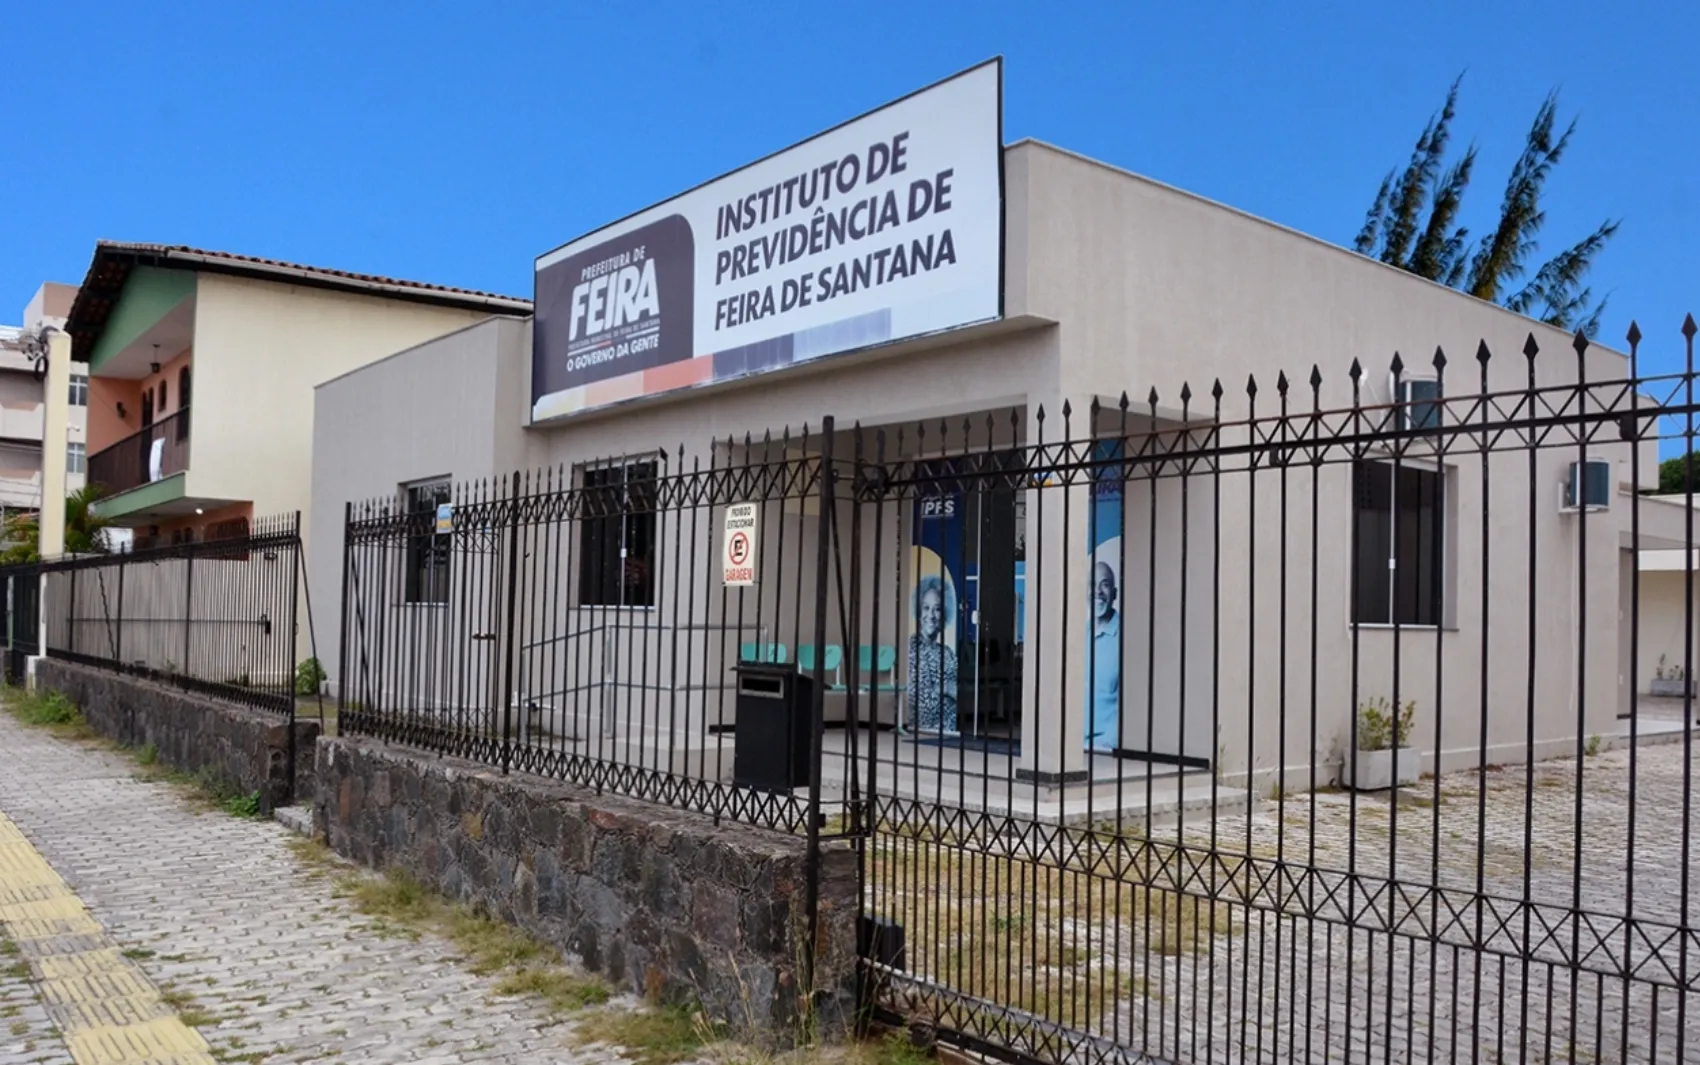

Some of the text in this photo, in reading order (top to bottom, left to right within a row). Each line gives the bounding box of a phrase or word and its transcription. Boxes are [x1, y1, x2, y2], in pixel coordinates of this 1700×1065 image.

[715, 168, 954, 286] PREVIDÊNCIA DE
[716, 130, 910, 241] INSTITUTO DE
[568, 258, 660, 341] FEIRA
[581, 245, 646, 281] PREFEITURA DE
[715, 228, 957, 331] FEIRA DE SANTANA
[566, 359, 574, 372] O
[575, 347, 615, 370] GOVERNO
[616, 344, 630, 358] DA
[630, 333, 660, 353] GENTE
